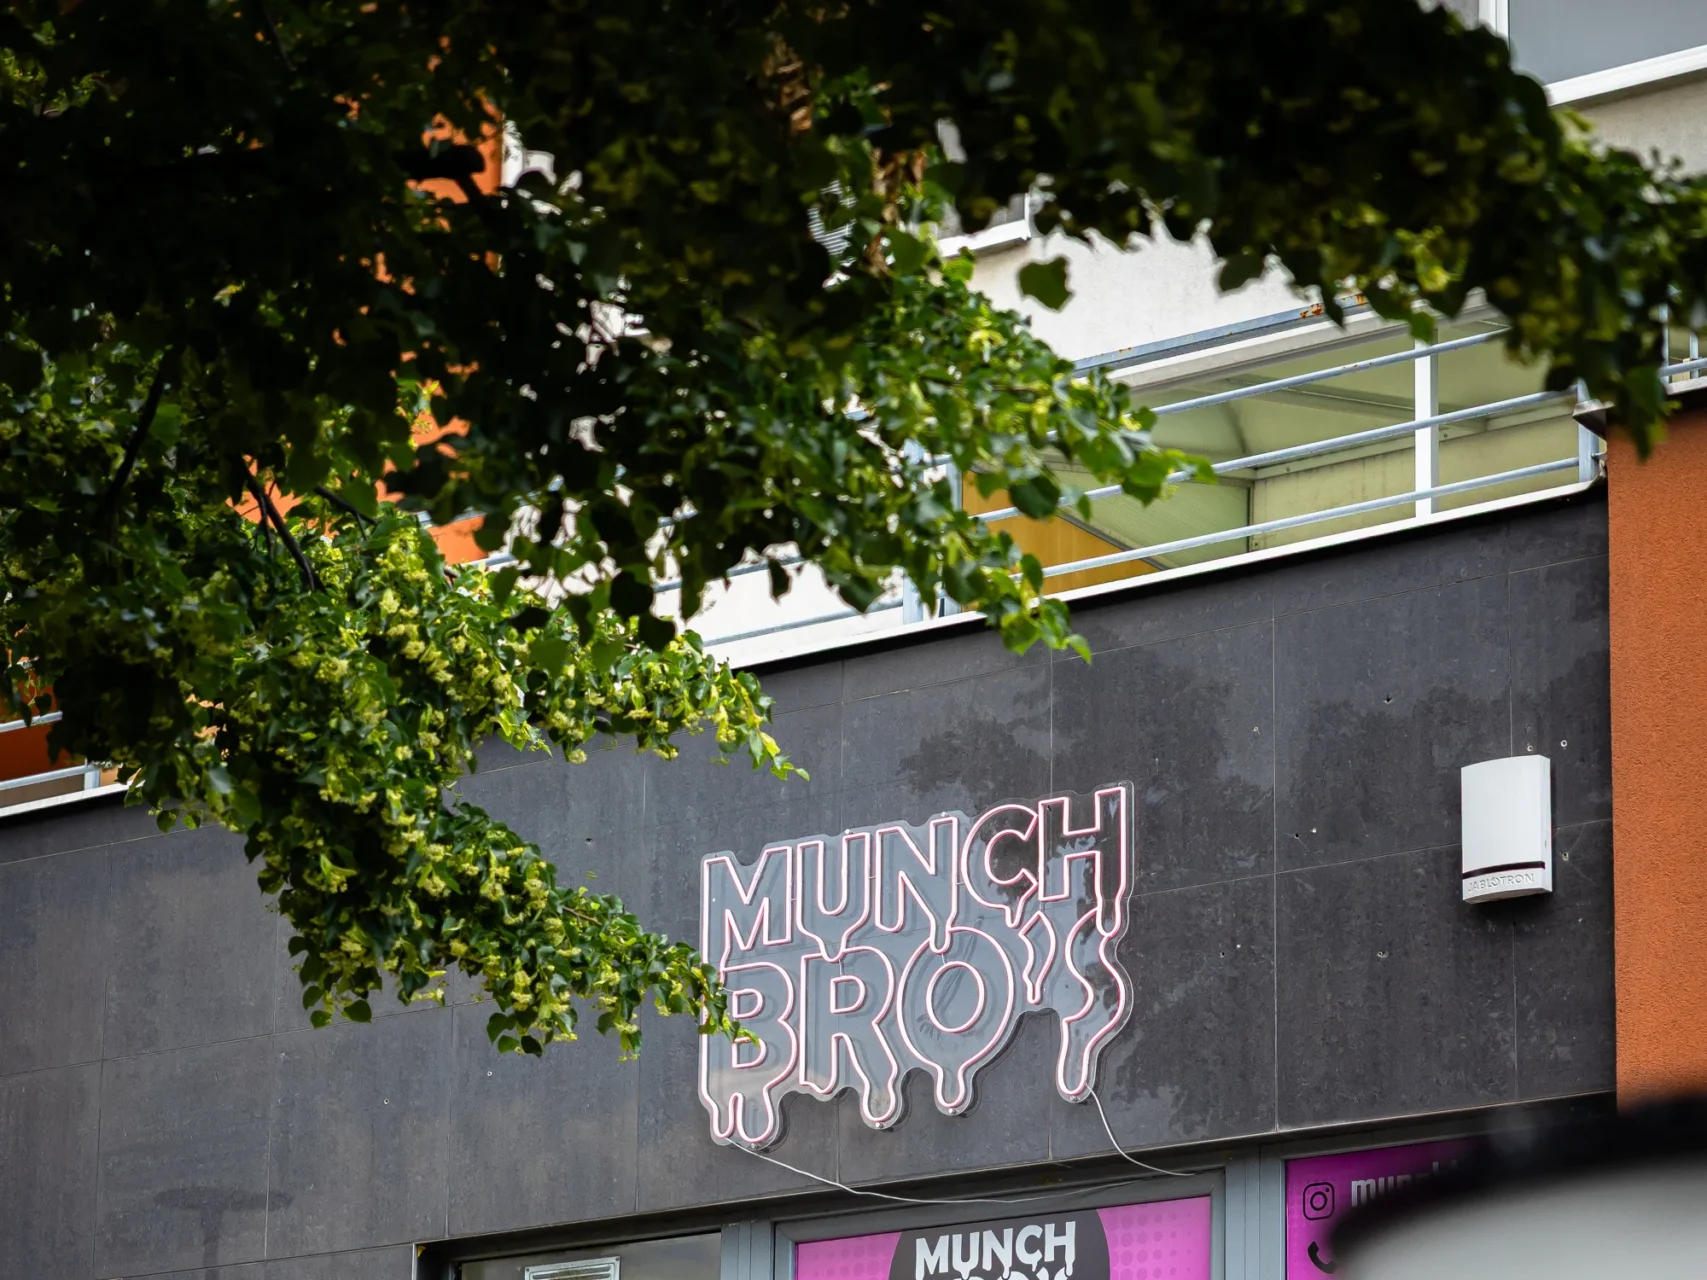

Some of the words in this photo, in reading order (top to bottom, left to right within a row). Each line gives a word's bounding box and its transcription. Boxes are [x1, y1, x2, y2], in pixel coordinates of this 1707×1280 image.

[702, 786, 1127, 962] MUNCH
[1468, 873, 1534, 892] JABLOTRON
[701, 908, 1125, 1143] BRO'S
